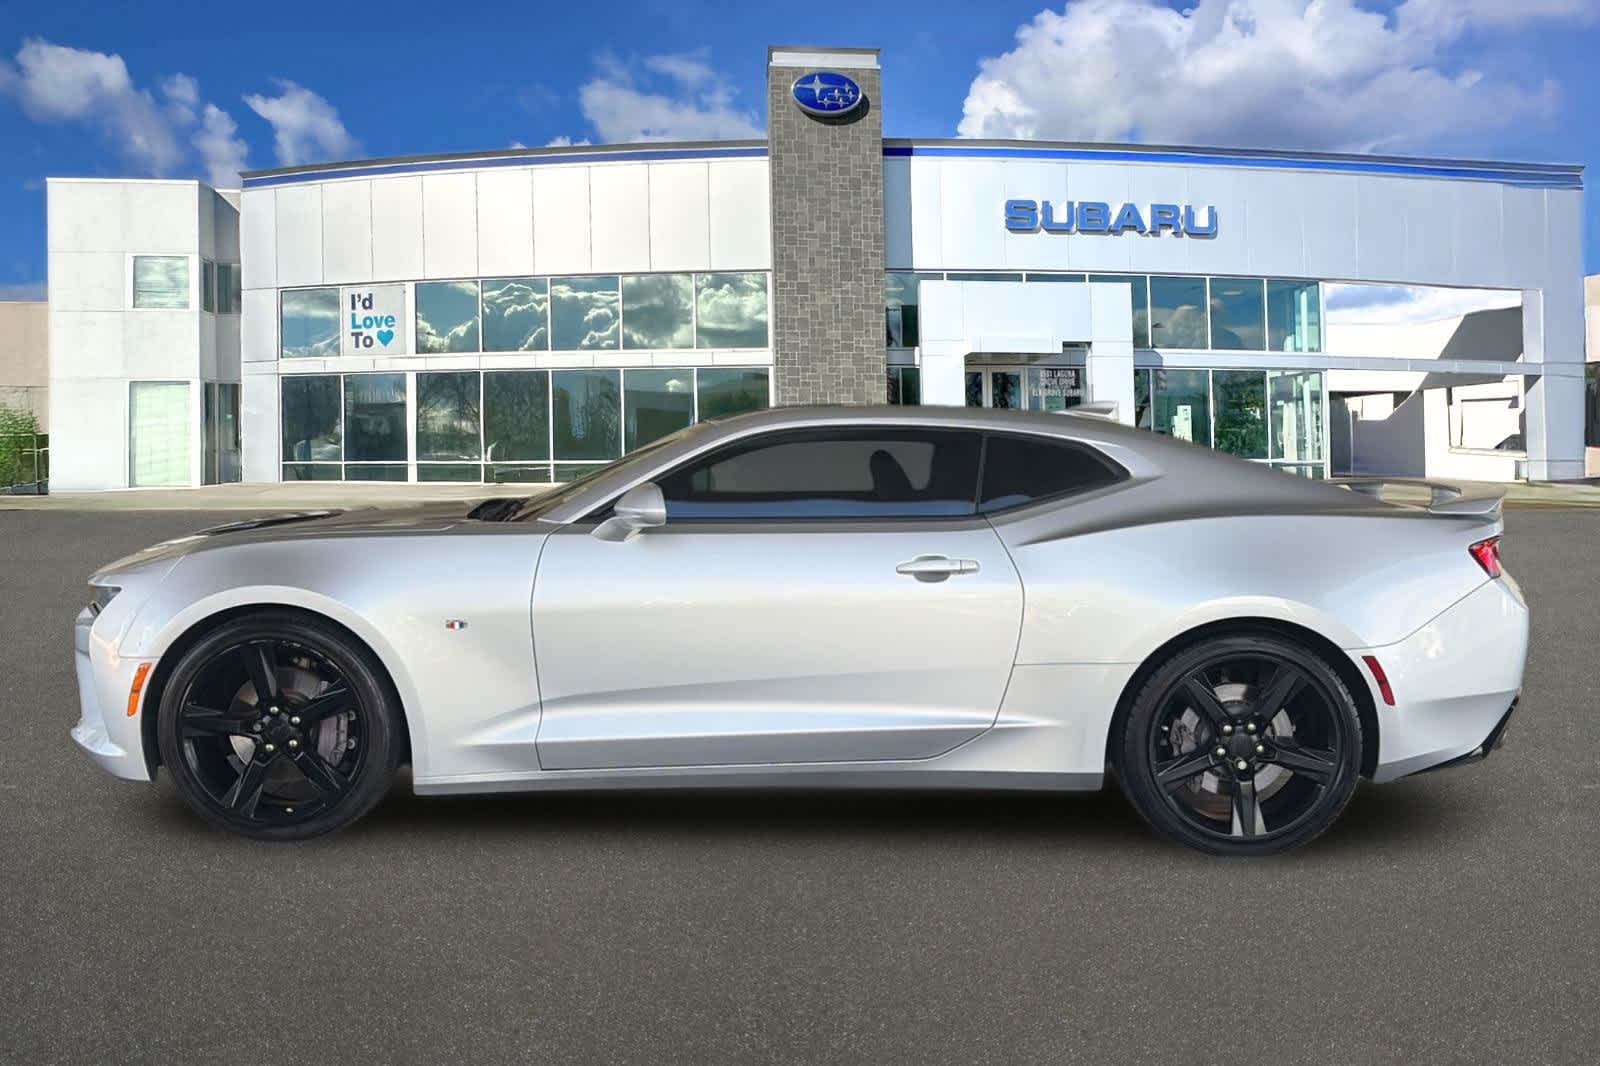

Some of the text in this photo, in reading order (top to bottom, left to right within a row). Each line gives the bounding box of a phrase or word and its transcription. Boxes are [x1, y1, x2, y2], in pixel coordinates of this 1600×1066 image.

[1004, 199, 1219, 238] SUBARU
[351, 293, 373, 310] I'd
[351, 313, 396, 329] Love
[351, 332, 374, 348] To
